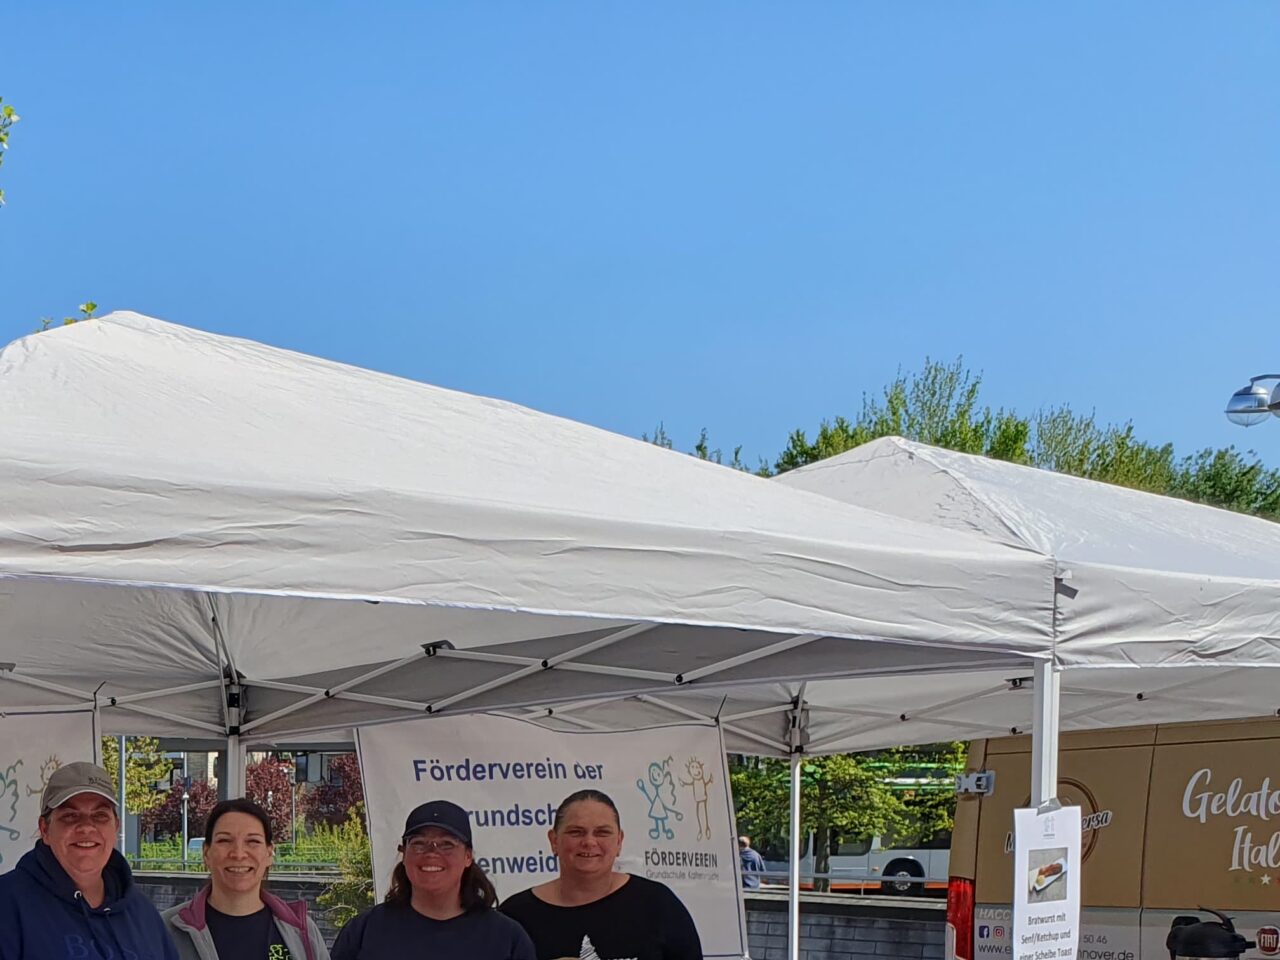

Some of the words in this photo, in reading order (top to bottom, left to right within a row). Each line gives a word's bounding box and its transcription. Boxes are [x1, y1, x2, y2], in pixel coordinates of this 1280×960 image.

[413, 757, 568, 782] Förderverein
[574, 761, 604, 780] der
[468, 803, 558, 827] undsch
[645, 848, 718, 868] FÖRDERVEREIN
[1028, 914, 1055, 926] Bratwurst
[1056, 912, 1066, 922] mit
[1021, 931, 1059, 945] Senf/Ketchup
[1060, 928, 1071, 939] und
[1261, 934, 1278, 948] FIAT
[1035, 949, 1057, 960] Scheibe
[1057, 947, 1072, 957] Toast
